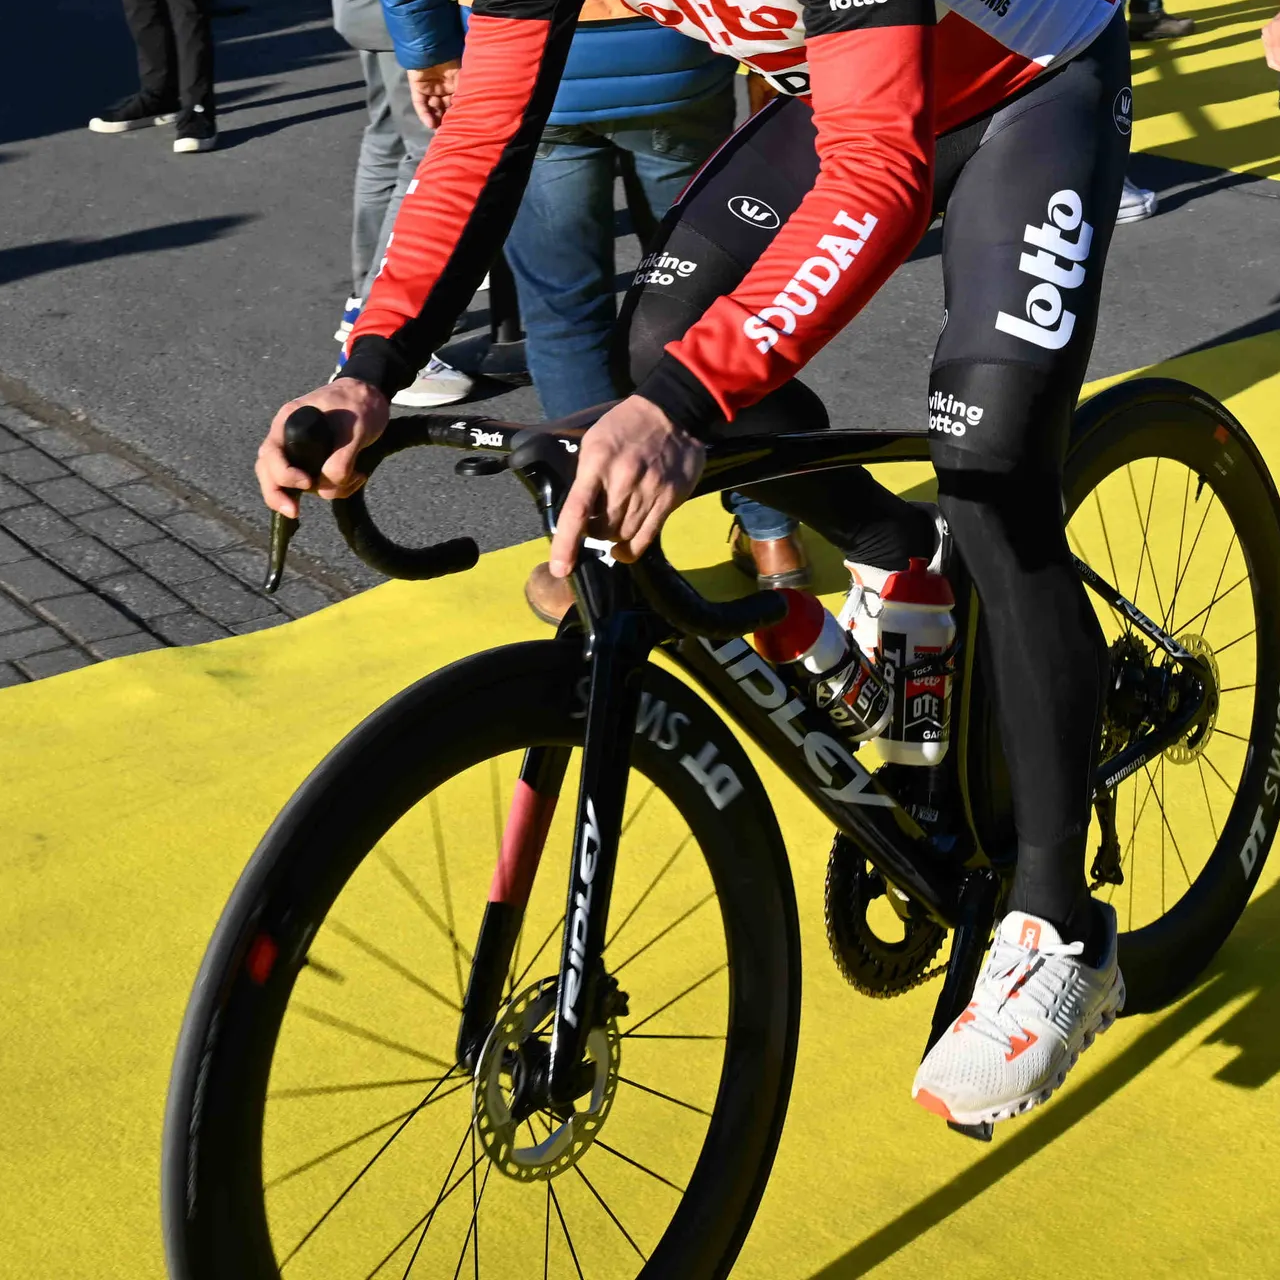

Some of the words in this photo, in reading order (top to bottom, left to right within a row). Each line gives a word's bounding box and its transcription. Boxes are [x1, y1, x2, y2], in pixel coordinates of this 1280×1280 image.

[631, 269, 675, 286] lotto
[636, 251, 698, 278] viking
[742, 208, 880, 355] SOUDAL
[993, 188, 1095, 351] lotto
[928, 390, 985, 427] viking
[1115, 596, 1193, 660] RIDLEY
[856, 676, 878, 712] OTE
[911, 664, 933, 677] Tacx
[696, 635, 898, 809] IDLEY
[912, 695, 940, 720] OTE
[679, 741, 746, 811] DT
[1104, 753, 1147, 789] SHIMANO
[1229, 803, 1268, 881] DT
[562, 795, 602, 1030] RIDLEY
